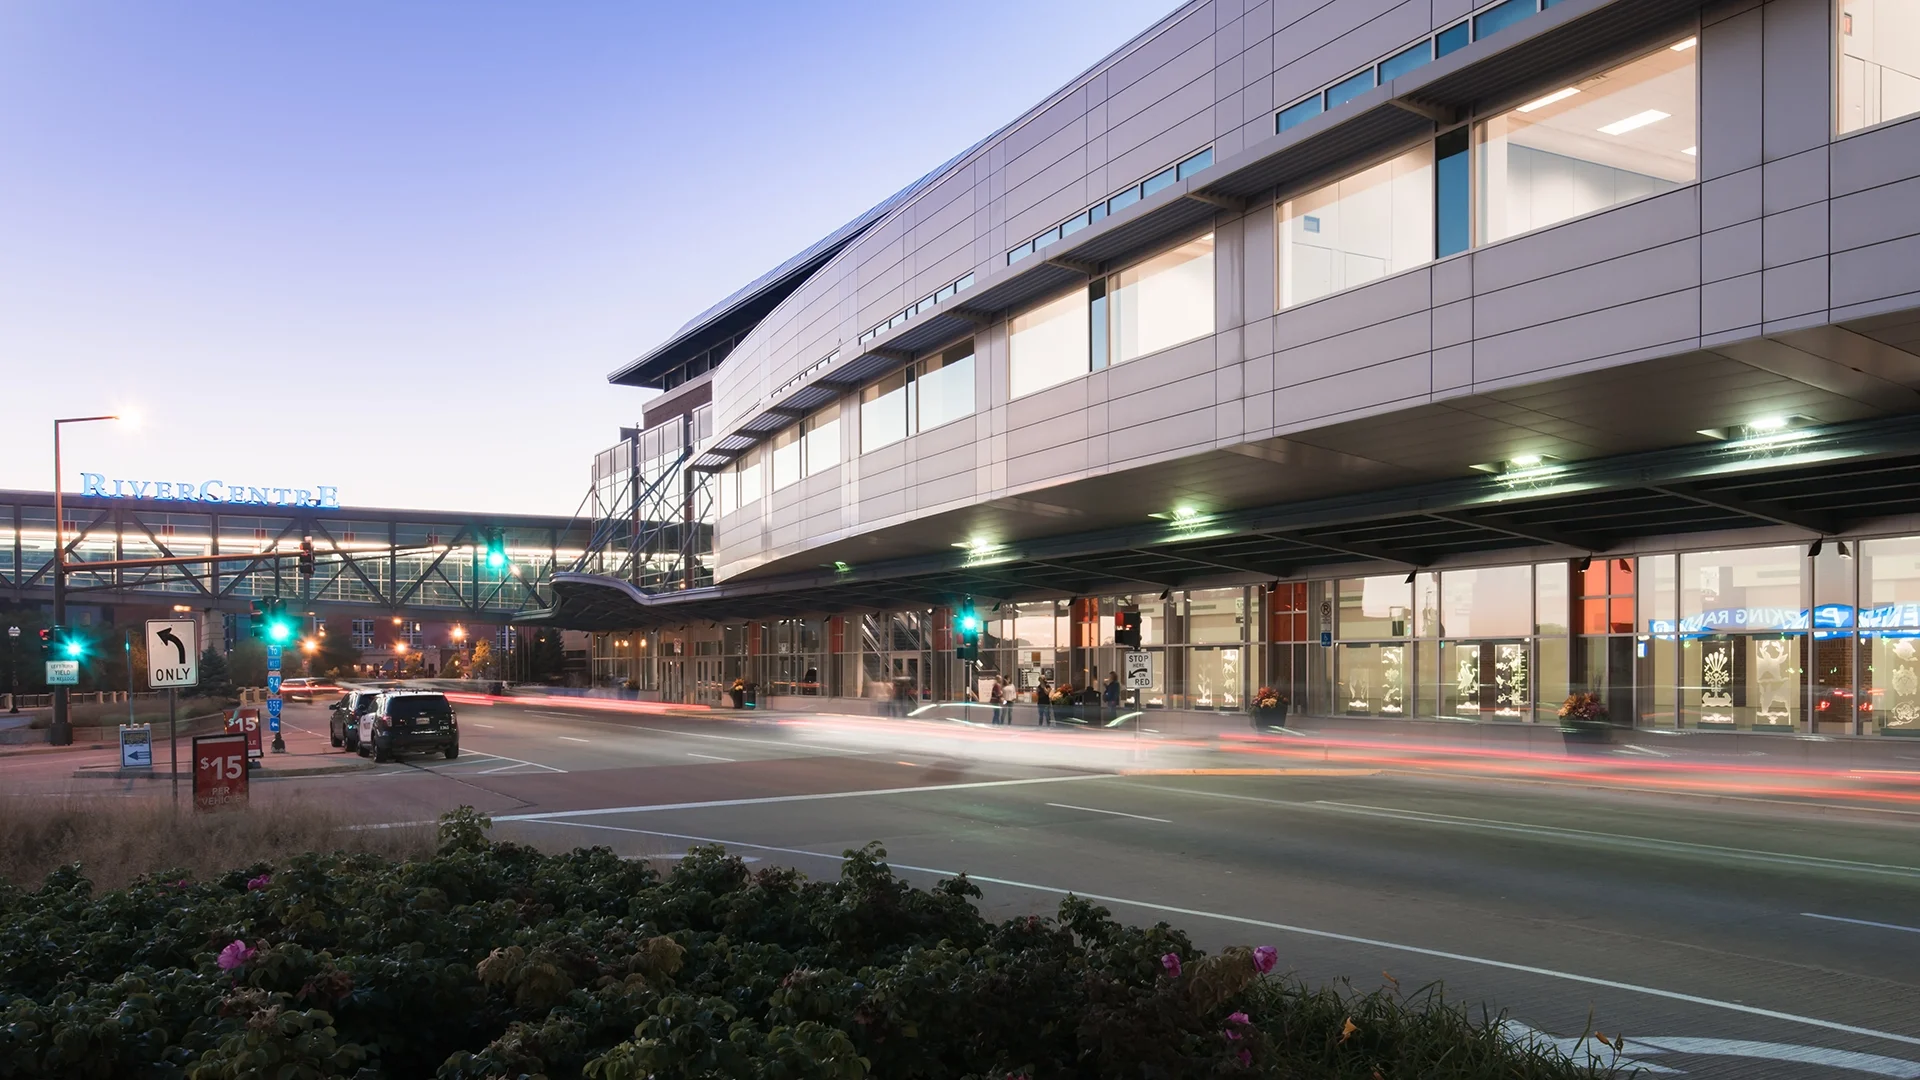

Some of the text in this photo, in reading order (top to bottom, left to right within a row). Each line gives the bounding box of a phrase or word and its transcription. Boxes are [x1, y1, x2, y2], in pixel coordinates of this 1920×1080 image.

[156, 668, 190, 681] ONLY
[269, 678, 279, 688] 94
[268, 701, 280, 712] 35E
[228, 717, 257, 732] $15
[200, 755, 243, 780] $15
[211, 786, 231, 796] PER
